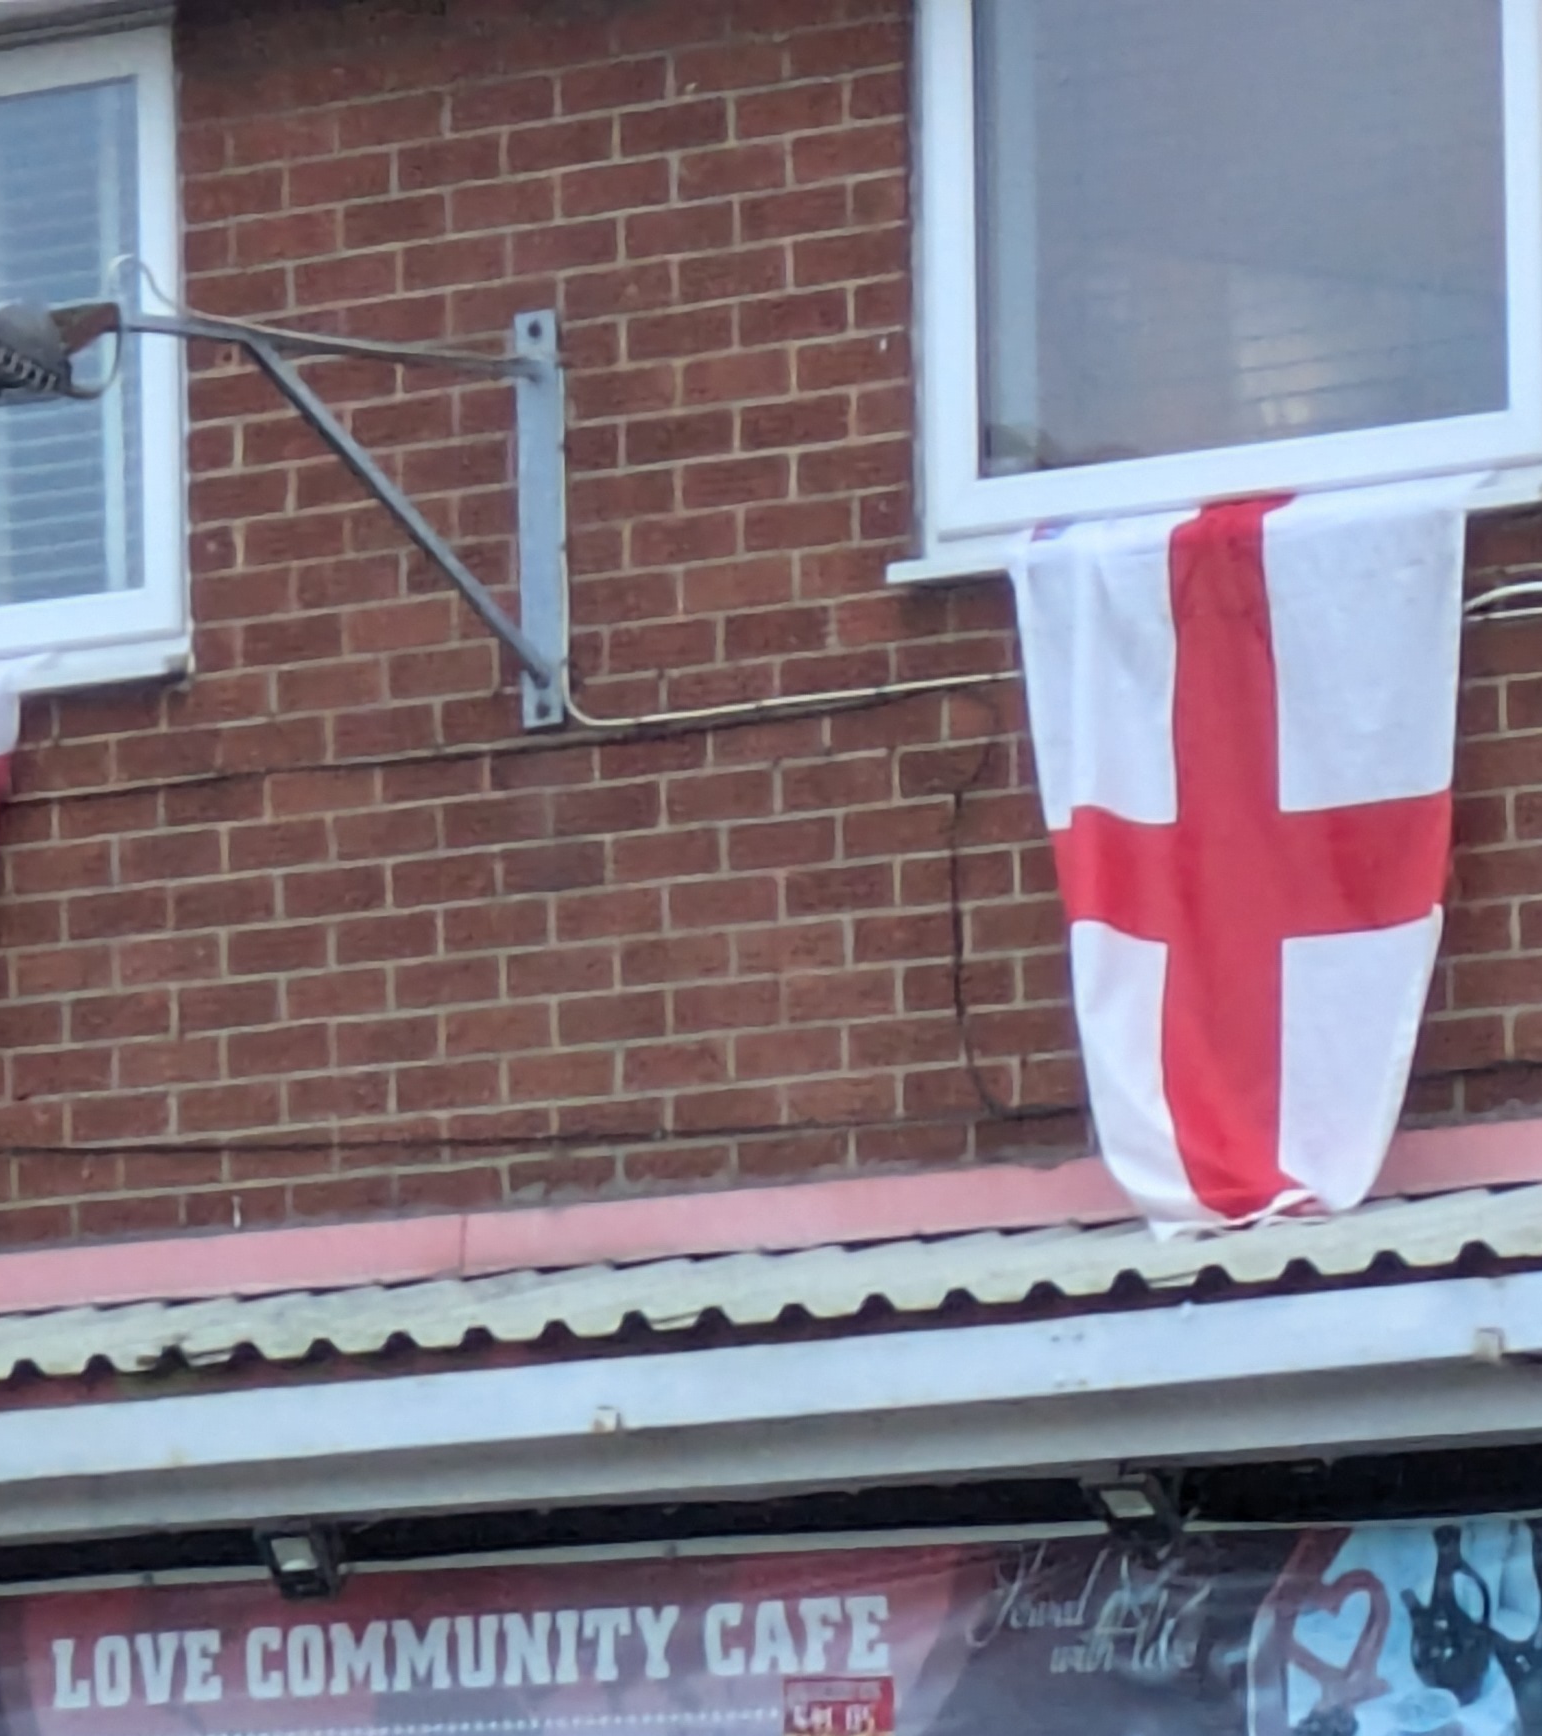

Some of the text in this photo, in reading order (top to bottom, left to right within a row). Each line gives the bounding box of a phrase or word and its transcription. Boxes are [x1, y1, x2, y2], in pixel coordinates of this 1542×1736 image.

[52, 1594, 891, 1709] LOVE COMMUNITY CAFE
